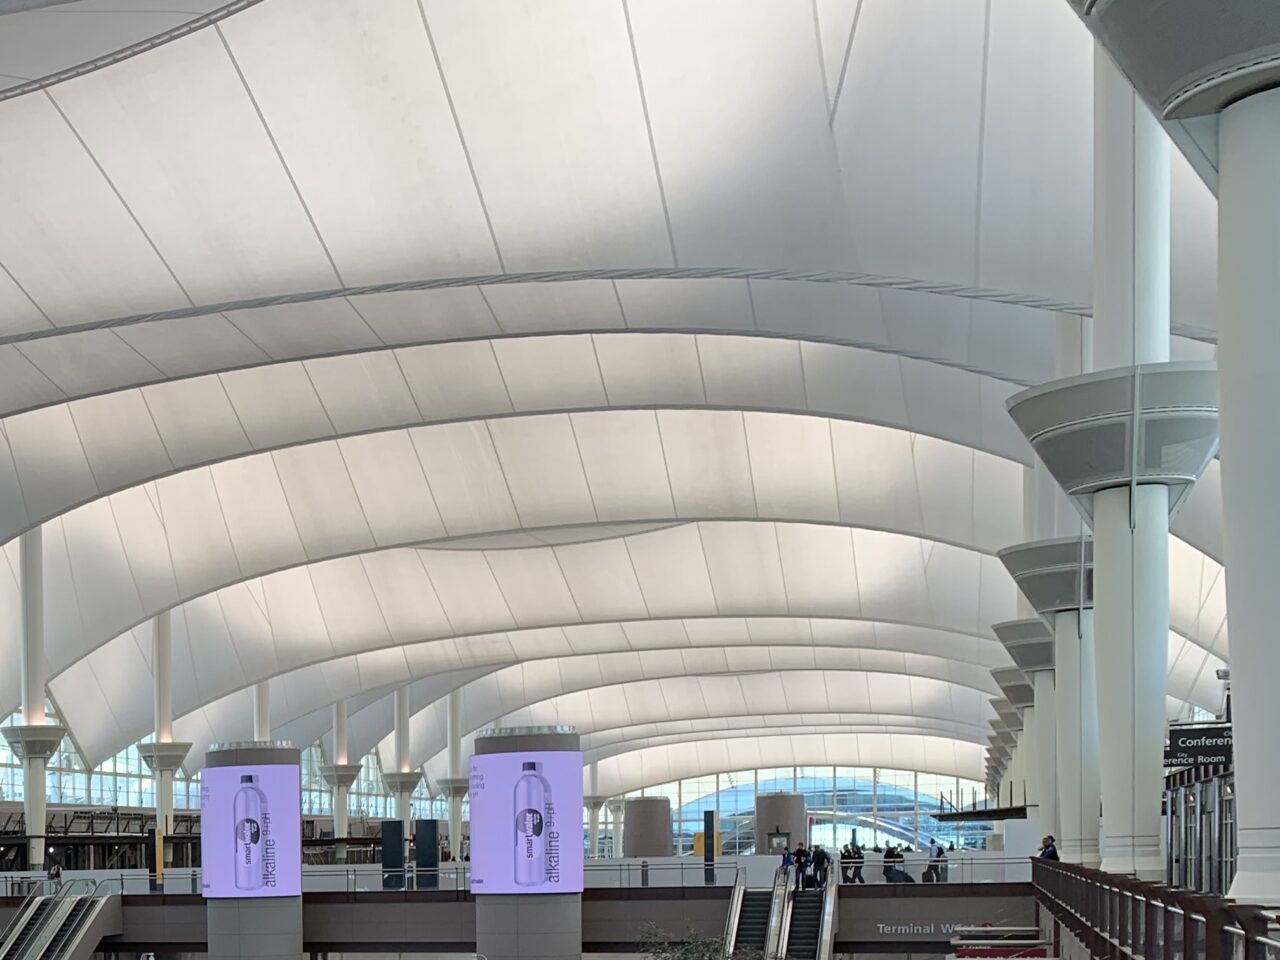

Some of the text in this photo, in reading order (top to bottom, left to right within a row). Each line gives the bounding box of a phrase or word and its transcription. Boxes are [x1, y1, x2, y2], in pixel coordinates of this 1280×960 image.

[1197, 755, 1225, 764] Room
[262, 839, 276, 888] alkaline
[545, 831, 560, 883] alkaline
[877, 923, 934, 934] Terminal
